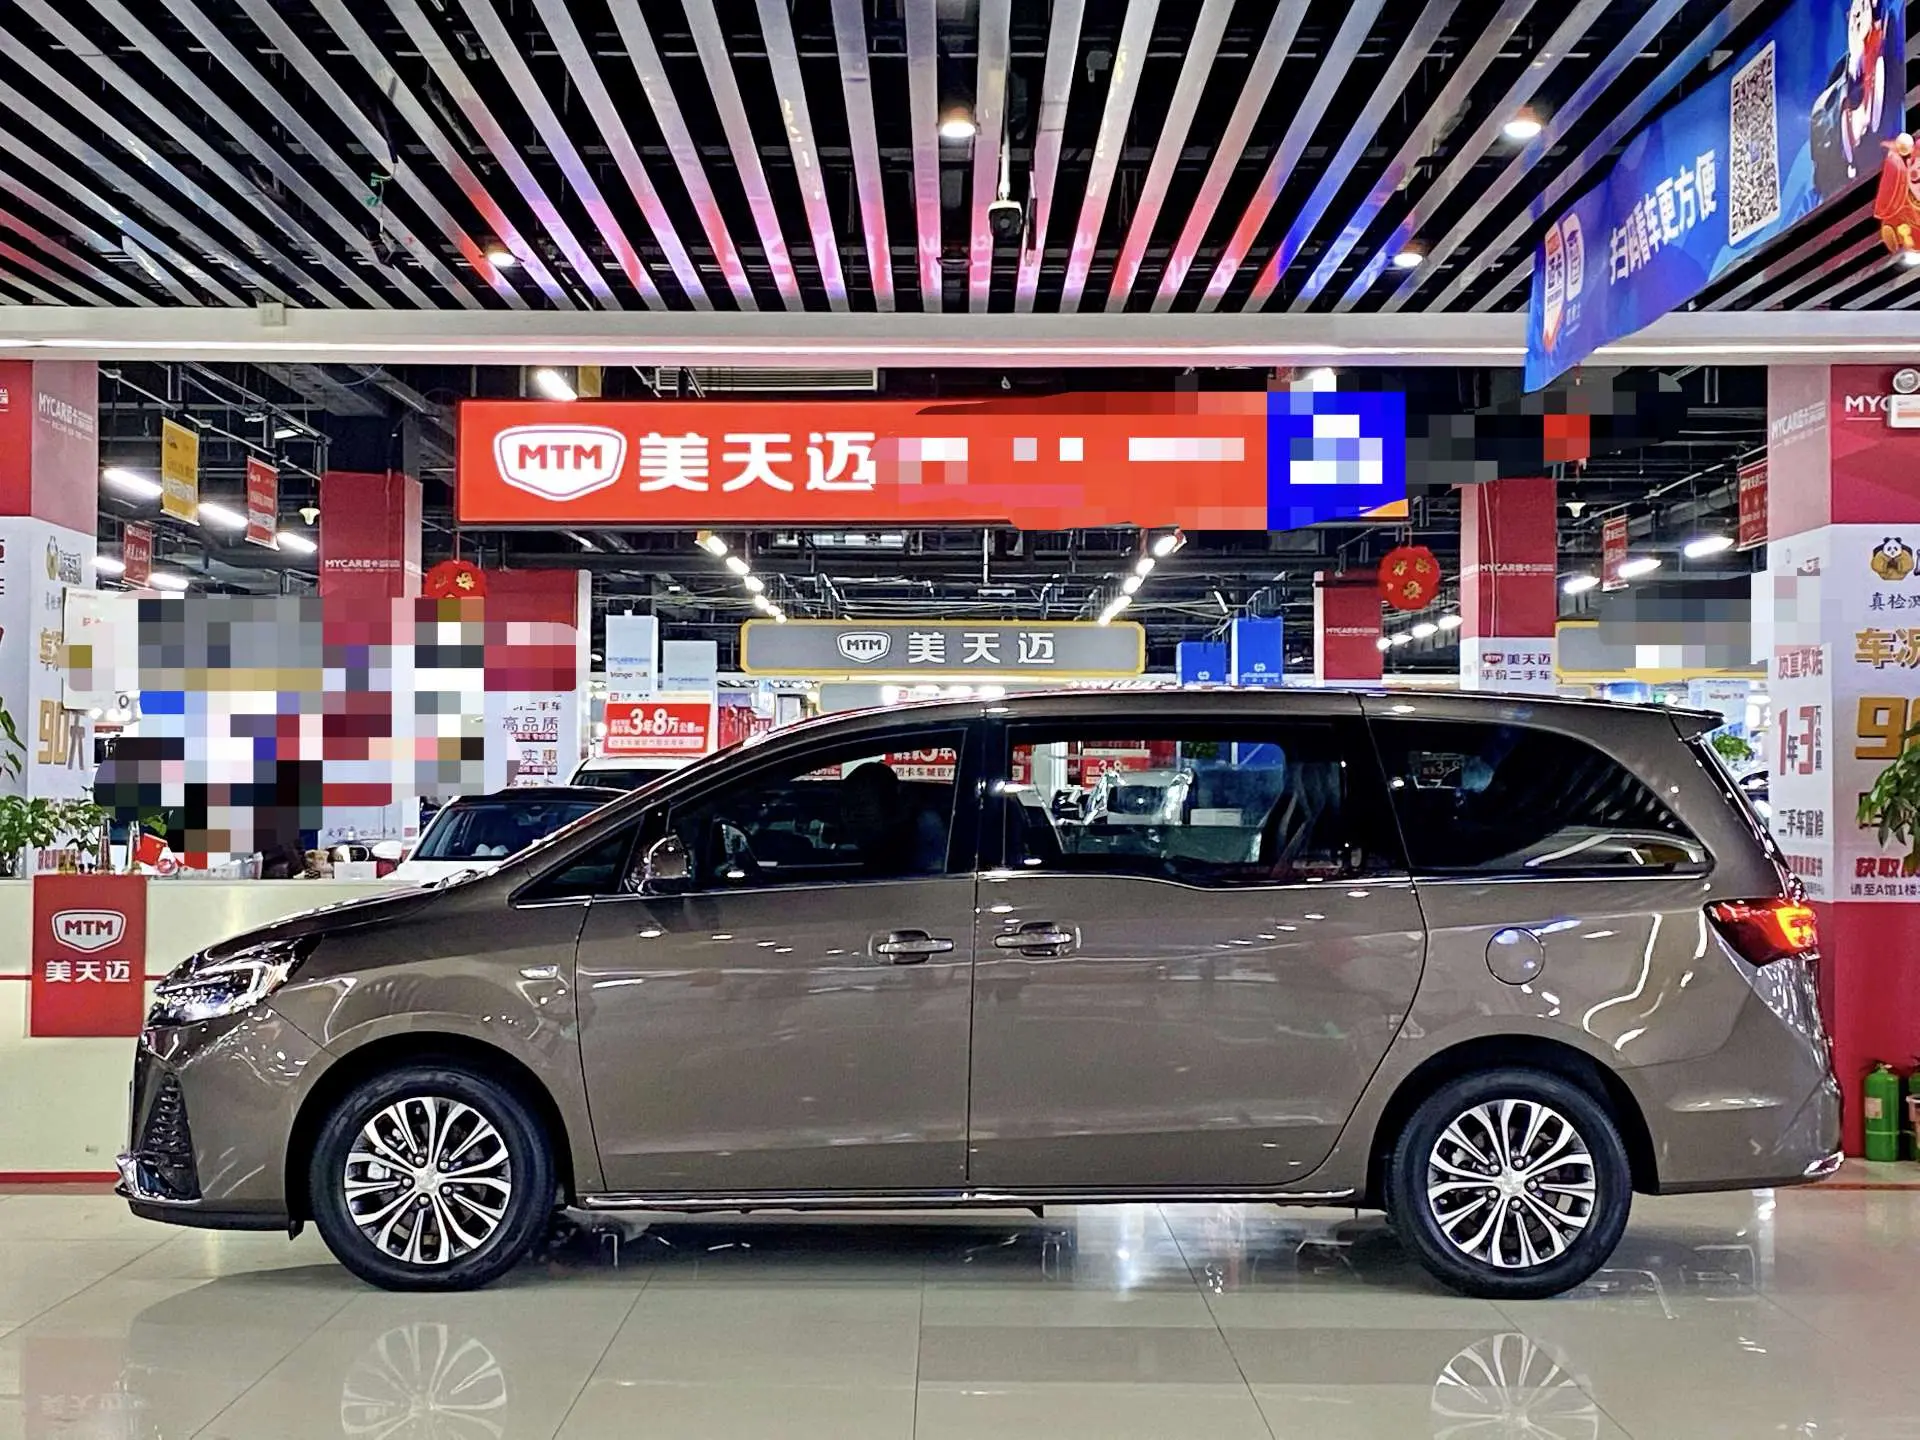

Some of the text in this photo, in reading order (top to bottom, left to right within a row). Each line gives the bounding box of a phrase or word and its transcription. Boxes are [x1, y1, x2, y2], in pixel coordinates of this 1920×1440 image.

[518, 445, 603, 470] MTM
[639, 431, 877, 492] 美天迈
[846, 639, 882, 651] MTM
[908, 632, 1055, 664] 美天迈
[503, 716, 558, 732] 高品质
[1851, 883, 1920, 896] 请至A馆1楼
[64, 919, 114, 937] MTM
[46, 960, 130, 983] 美天迈
